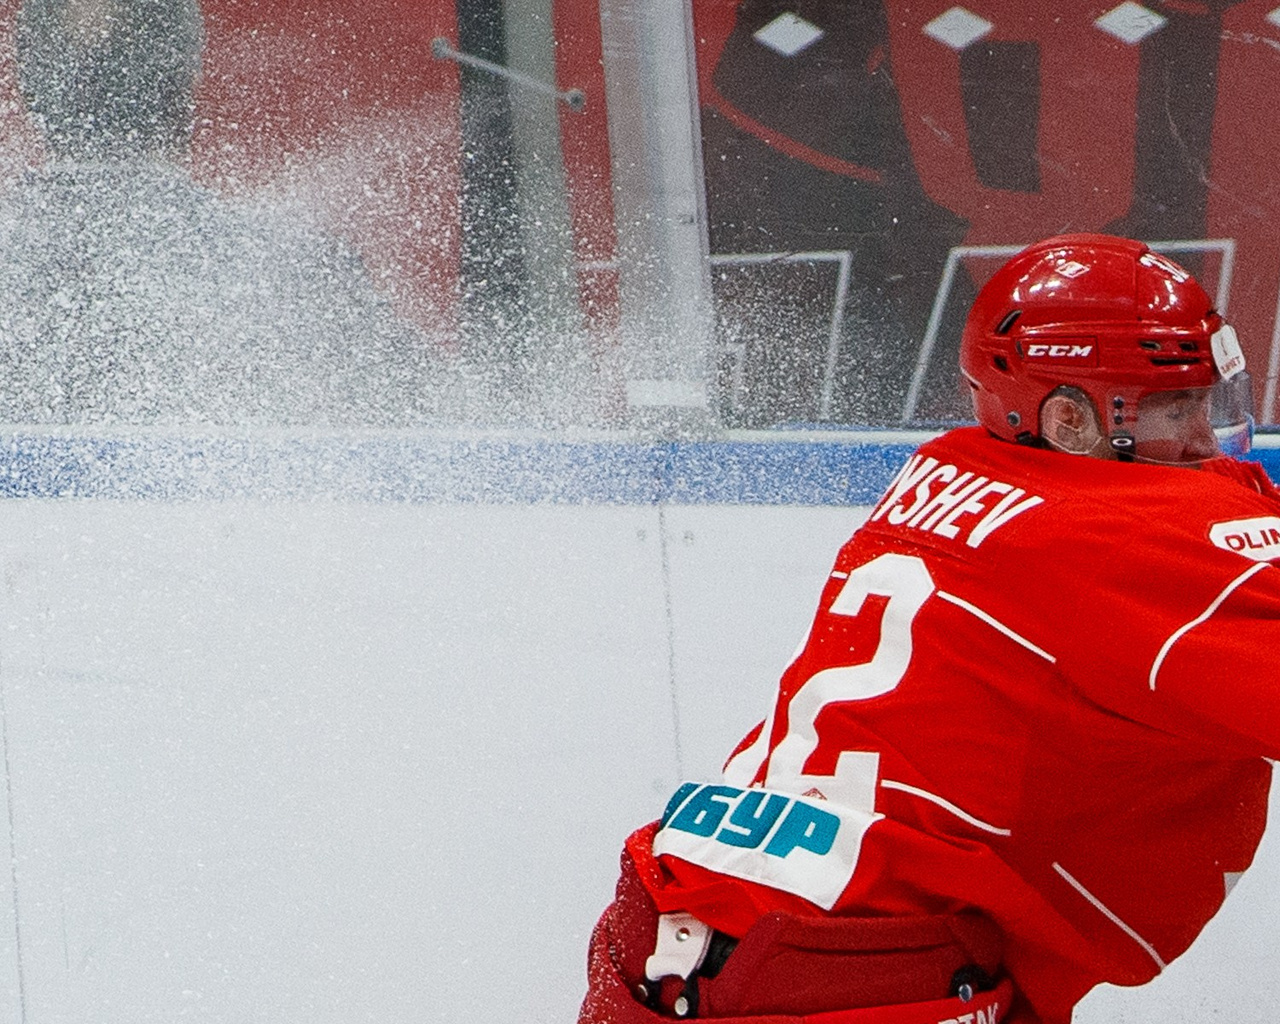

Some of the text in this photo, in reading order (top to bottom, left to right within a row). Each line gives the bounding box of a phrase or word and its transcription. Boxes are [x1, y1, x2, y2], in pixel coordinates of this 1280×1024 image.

[1027, 344, 1093, 357] CCM
[870, 454, 1045, 549] YSHEV
[722, 552, 936, 816] 2
